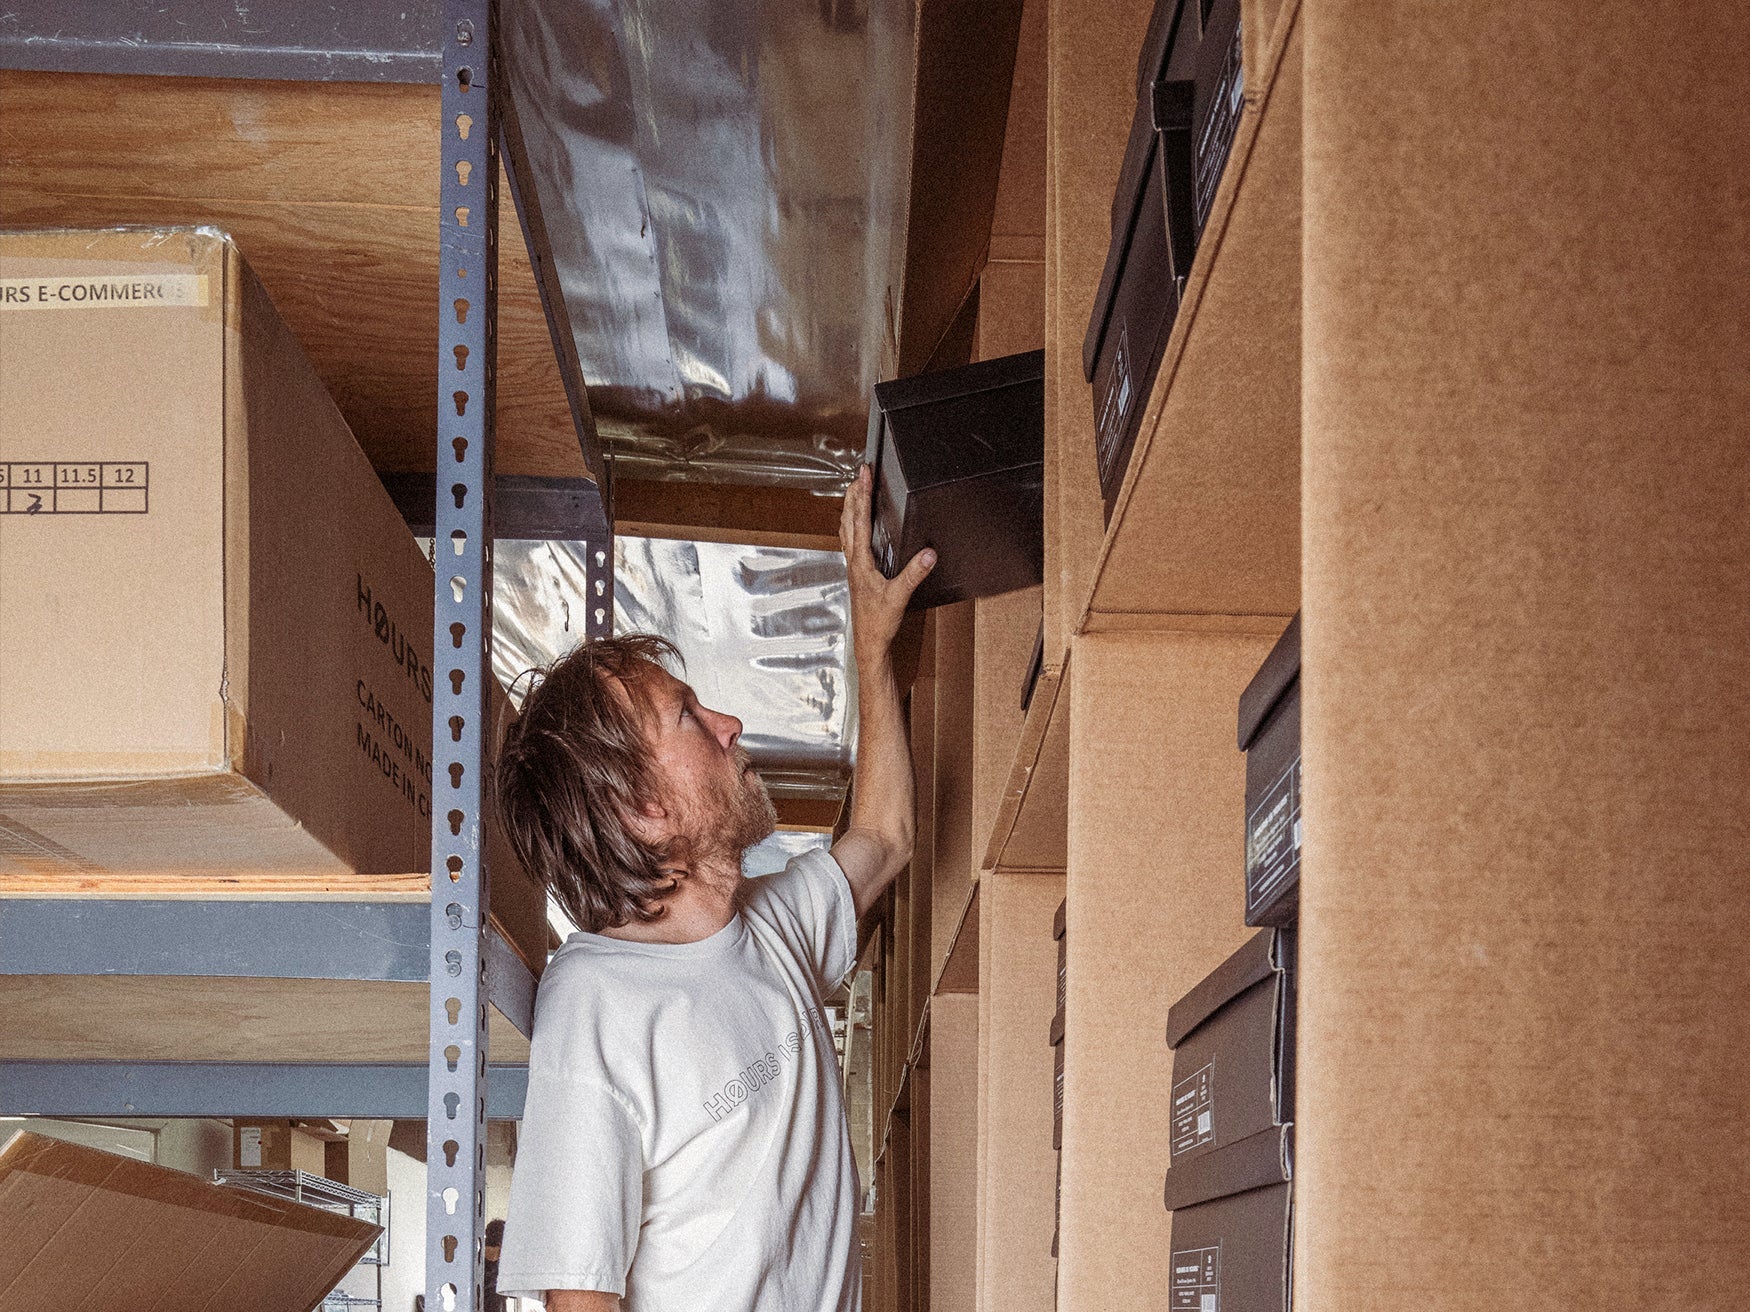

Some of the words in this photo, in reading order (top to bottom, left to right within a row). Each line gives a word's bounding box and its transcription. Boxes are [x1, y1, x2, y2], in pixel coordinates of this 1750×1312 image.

[0, 286, 30, 303] RS
[23, 468, 42, 483] 11
[61, 468, 97, 483] 11.5
[115, 468, 134, 483] 12
[357, 679, 412, 763] CARTON
[357, 722, 399, 788] MADE
[402, 772, 416, 807] IN
